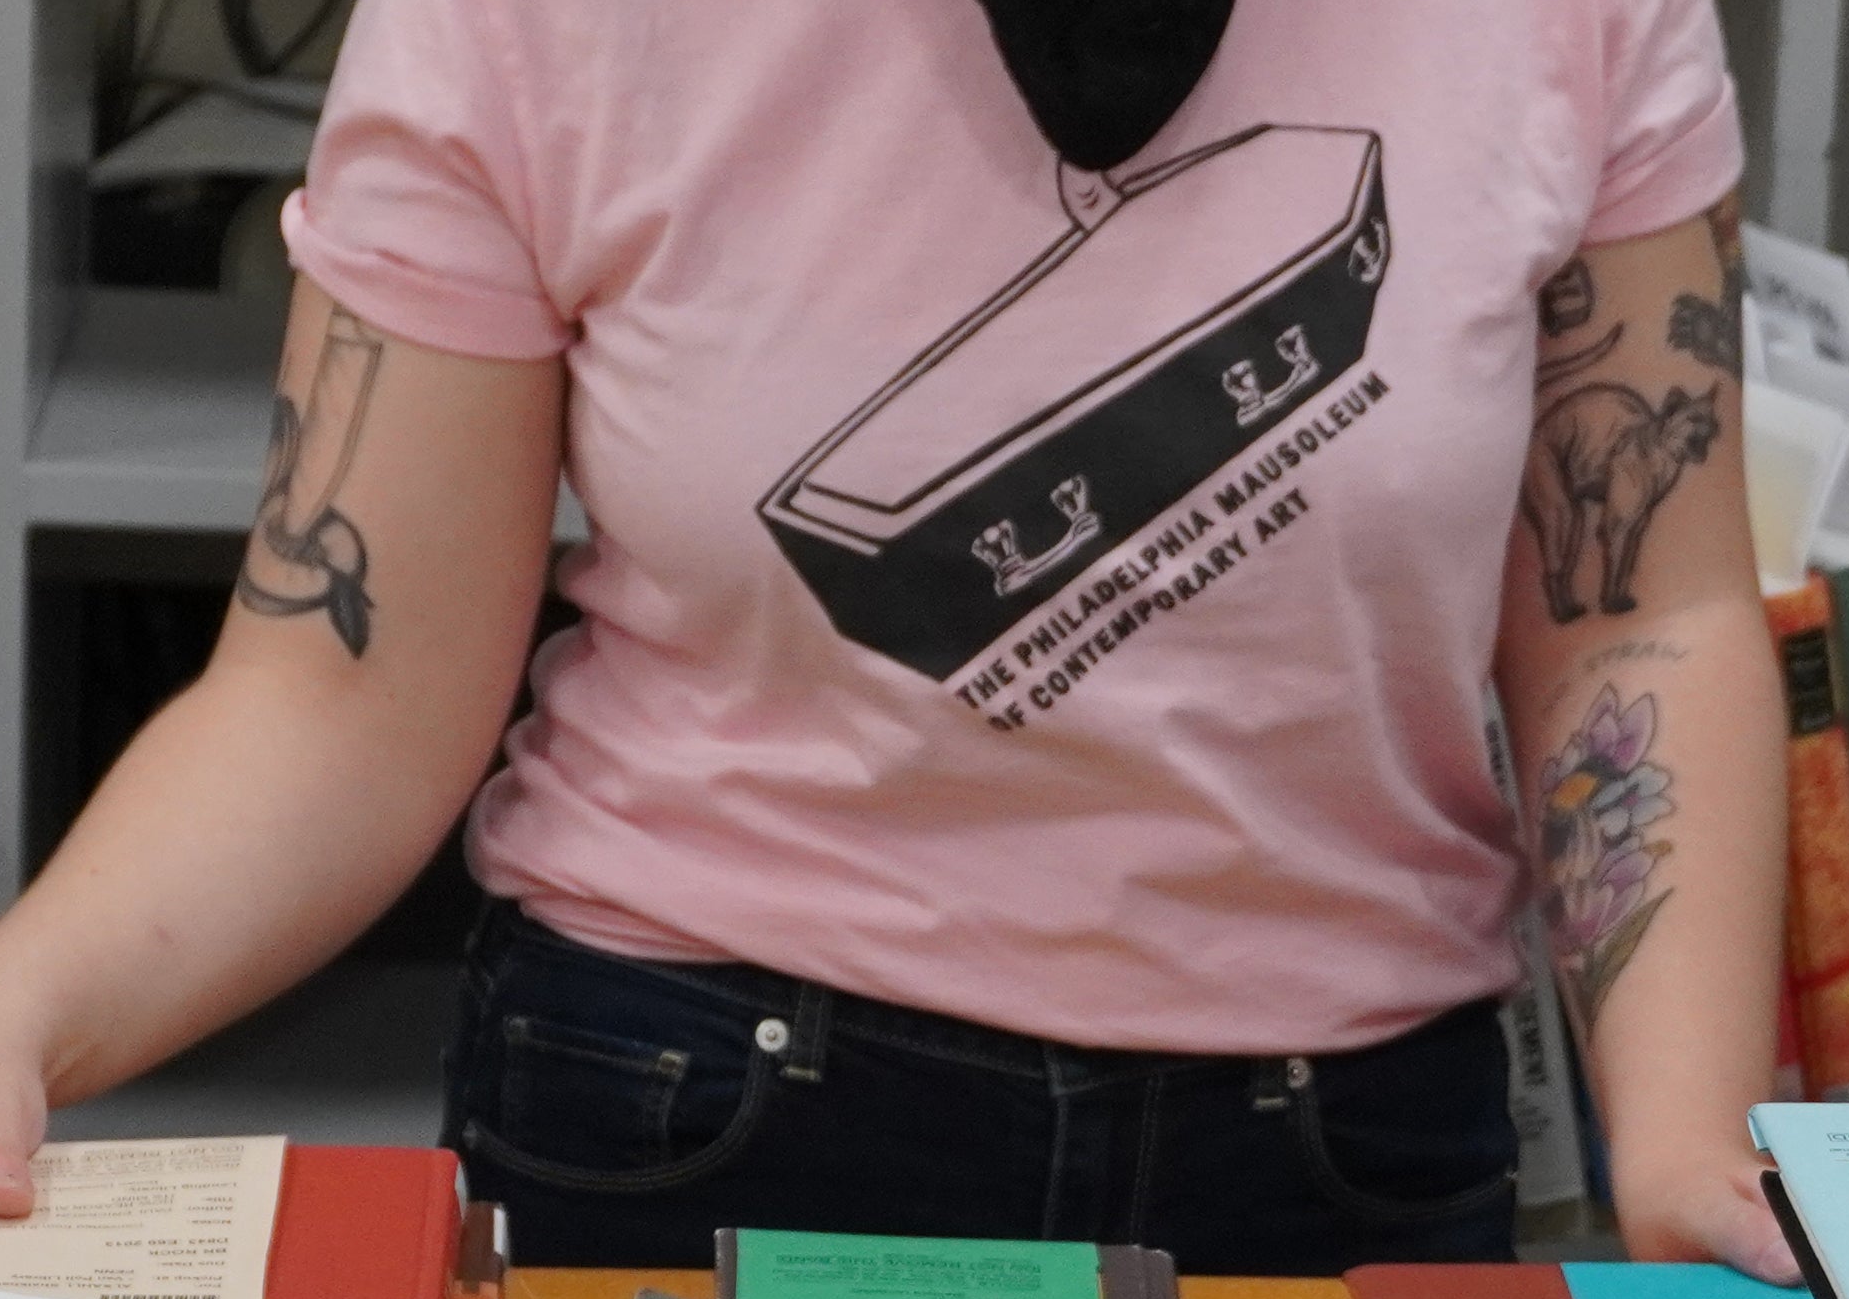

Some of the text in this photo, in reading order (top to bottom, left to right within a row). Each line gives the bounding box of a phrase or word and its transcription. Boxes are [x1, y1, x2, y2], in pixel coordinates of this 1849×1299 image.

[955, 371, 1390, 709] THE PHILADELPHIA MAUSOLEUM
[987, 488, 1311, 731] OF CONTEMPORARY ART
